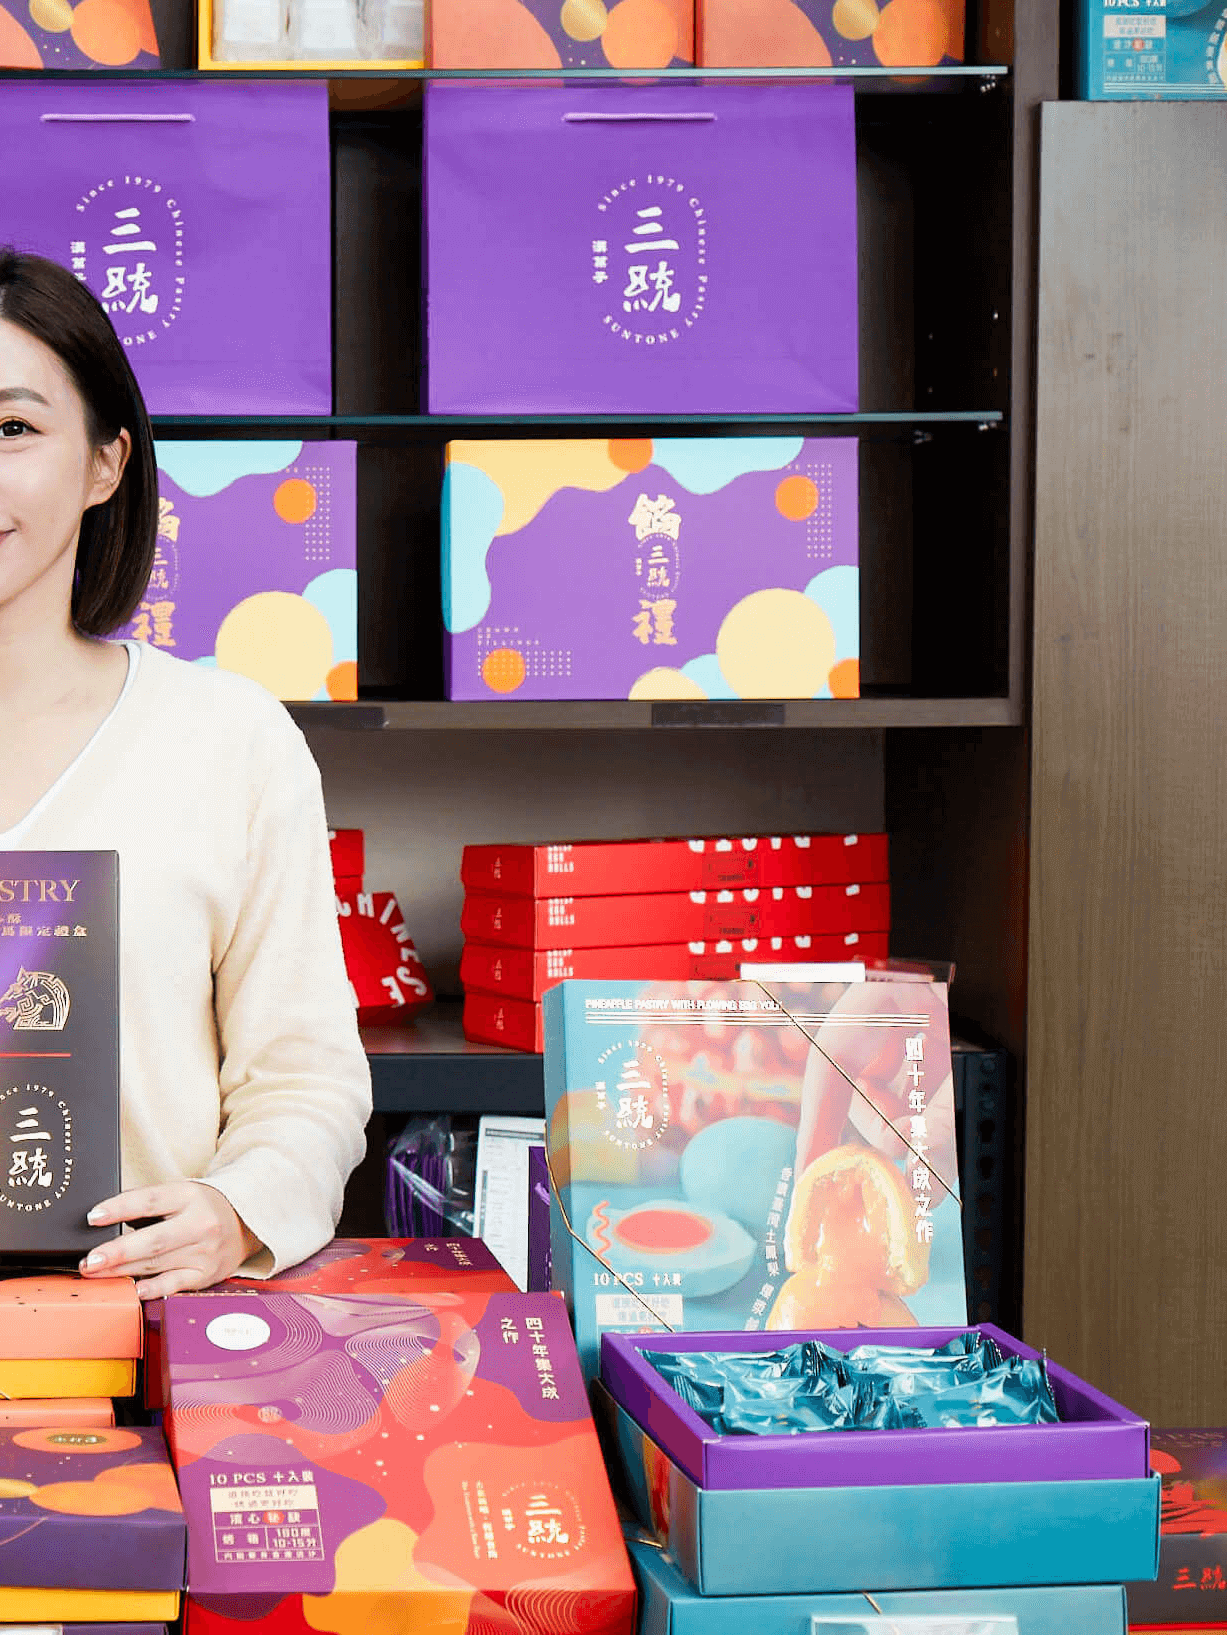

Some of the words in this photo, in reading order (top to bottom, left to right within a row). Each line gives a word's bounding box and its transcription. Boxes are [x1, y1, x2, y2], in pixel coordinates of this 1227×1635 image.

[76, 179, 115, 212] Since
[125, 175, 162, 193] 1979
[597, 178, 636, 212] Since
[647, 174, 685, 193] 1979
[167, 198, 184, 267] Chinese
[689, 198, 708, 265] Chinese
[101, 207, 159, 314] 三統
[623, 206, 682, 313] 三統
[162, 277, 186, 328] Pastry
[685, 275, 709, 328] Pastry
[603, 315, 679, 345] SUNTONE
[647, 545, 670, 587] 三統
[585, 1000, 632, 1009] PINEAPPLE
[635, 1000, 669, 1010] PASTRY
[671, 1000, 695, 1010] WITH
[26, 1084, 55, 1097] 1979
[616, 1060, 654, 1128] 三統
[8, 1107, 53, 1188] 三統
[58, 1100, 72, 1151] Chinese
[905, 1037, 933, 1243] 四十年集大成之作
[594, 1272, 610, 1286] 10
[614, 1272, 644, 1286] PCS
[500, 1317, 519, 1344] 之作
[525, 1317, 560, 1400] 四十年集大成
[210, 1473, 227, 1486] 10
[233, 1472, 266, 1484] PCS
[525, 1495, 569, 1544] 三統
